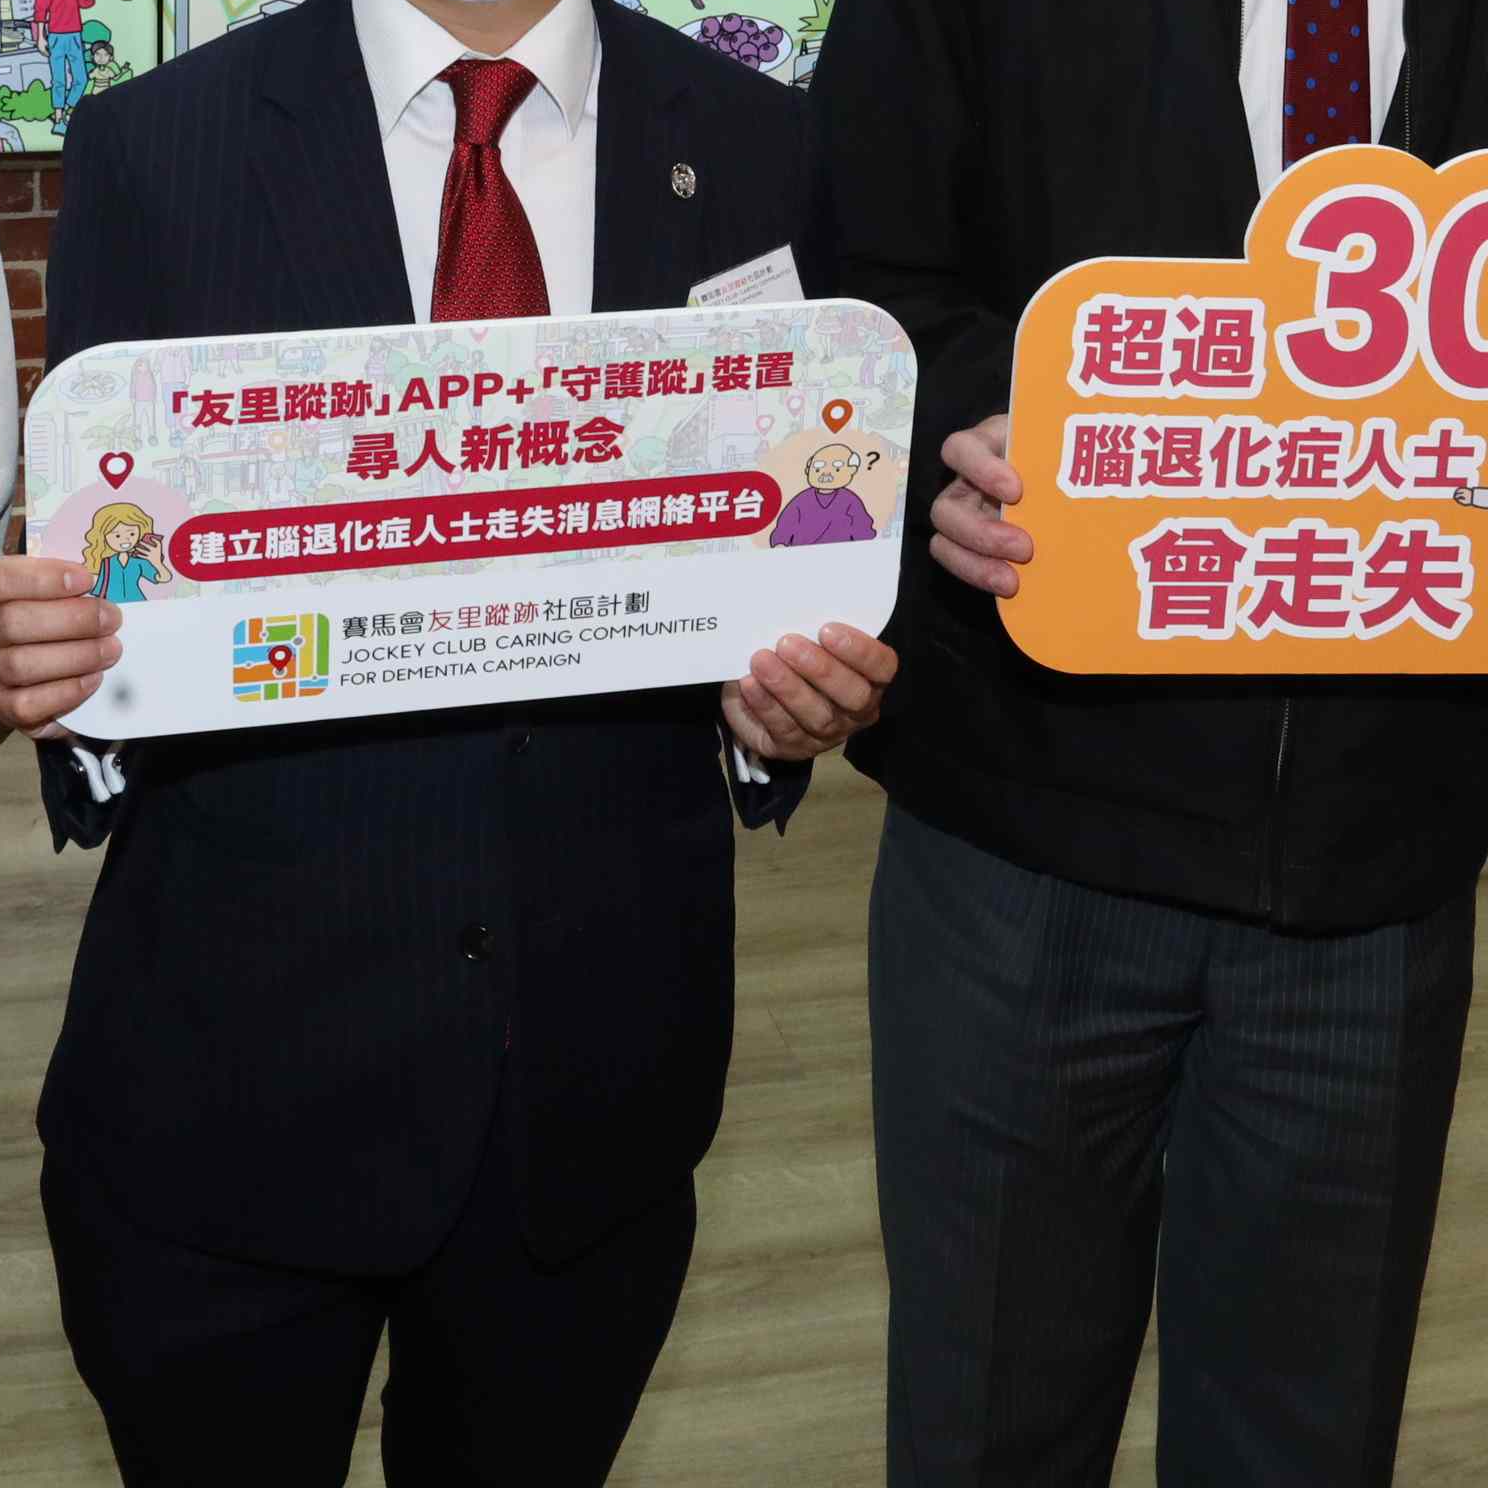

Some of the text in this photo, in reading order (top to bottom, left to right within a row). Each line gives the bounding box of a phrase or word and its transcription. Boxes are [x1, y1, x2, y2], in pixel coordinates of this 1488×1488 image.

[1080, 302, 1257, 390] 超過
[172, 351, 795, 429] 「友里蹤跡」APP+「守護蹤」裝置
[346, 417, 625, 481] 尋人新概念
[1069, 424, 1479, 490] 腦退化症人士
[189, 488, 766, 566] 建立腦退化症人士走失消息網絡平台
[1141, 528, 1466, 632] 曾走失
[341, 616, 718, 664] JOCKEY CLUB CARING COMMUNITIES
[342, 591, 651, 640] 賽馬會友里蹤跡社區計劃
[340, 652, 582, 687] FOR DEMENTIA CAMPAIGN
